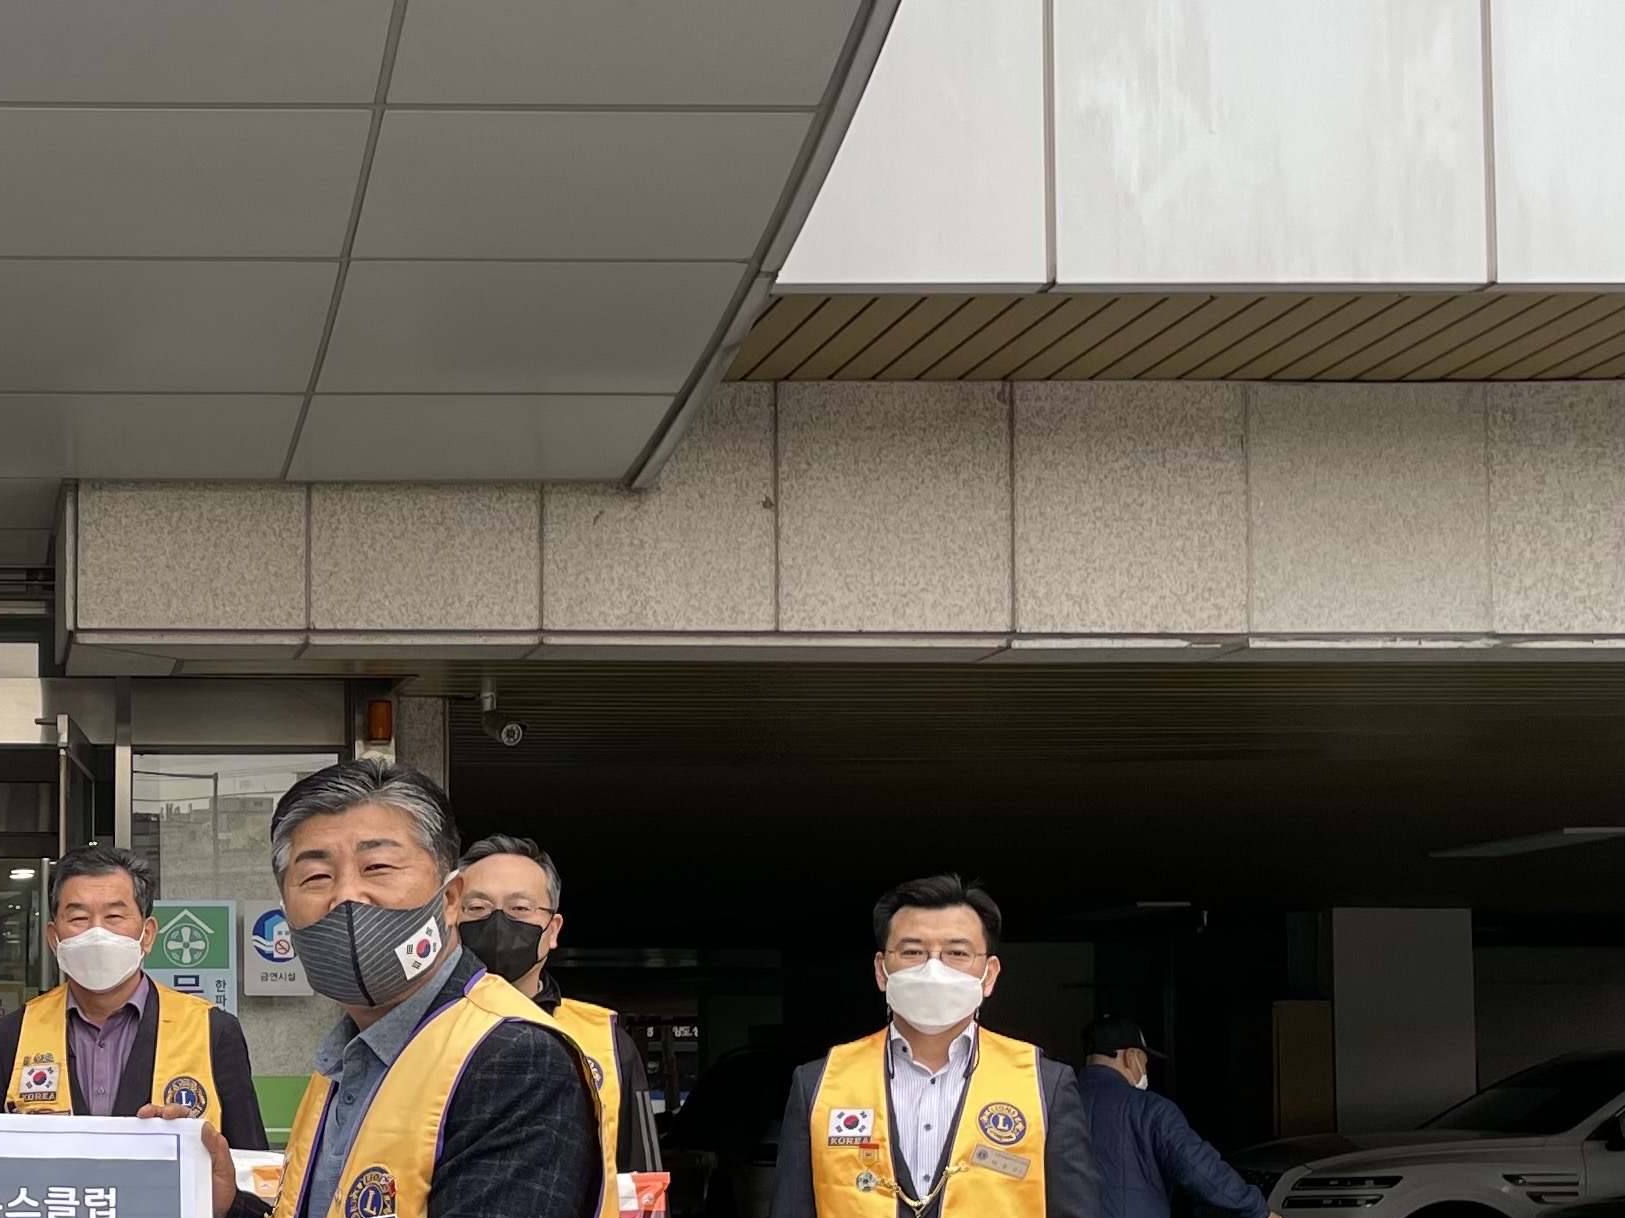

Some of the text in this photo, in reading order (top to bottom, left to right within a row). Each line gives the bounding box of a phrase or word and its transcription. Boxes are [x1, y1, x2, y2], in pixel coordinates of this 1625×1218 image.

[260, 972, 296, 982] 금연시설
[180, 1090, 192, 1107] L
[997, 1114, 1009, 1131] L
